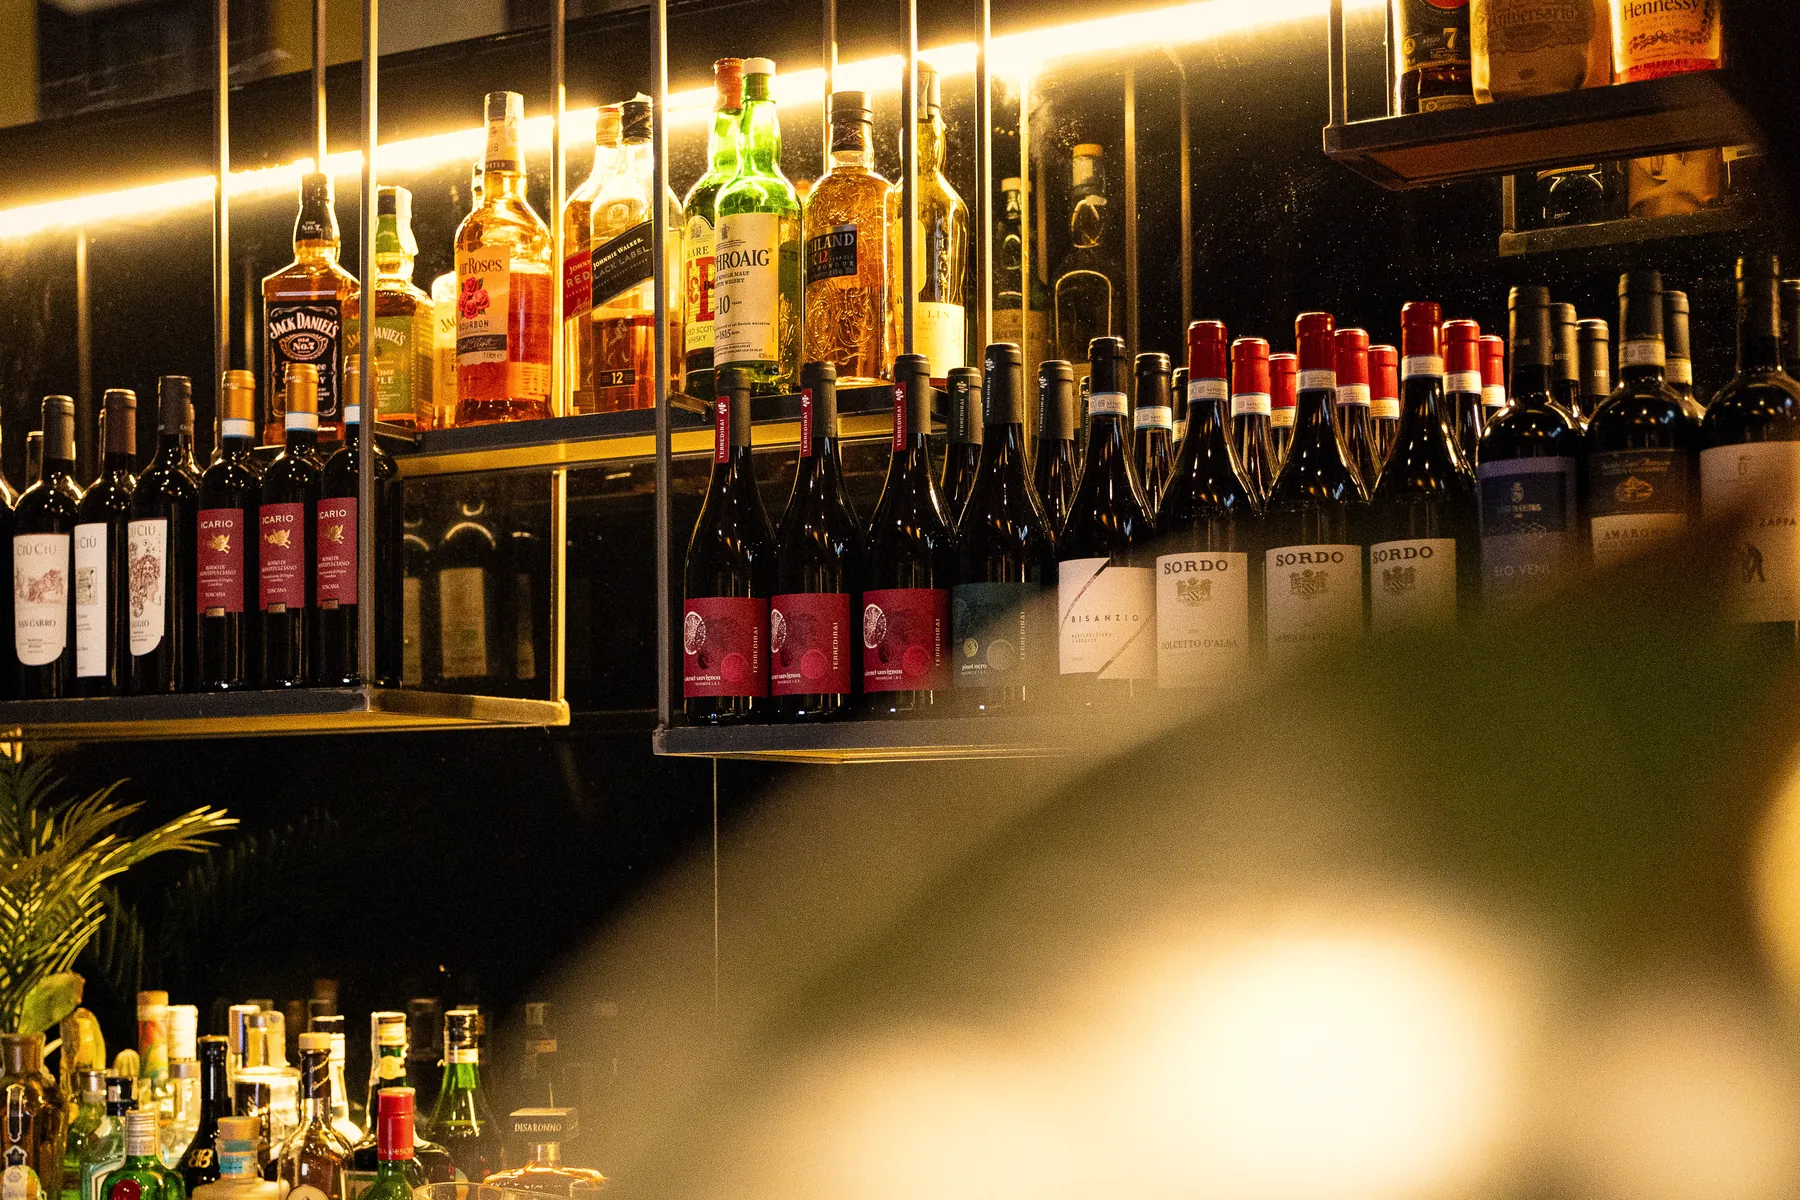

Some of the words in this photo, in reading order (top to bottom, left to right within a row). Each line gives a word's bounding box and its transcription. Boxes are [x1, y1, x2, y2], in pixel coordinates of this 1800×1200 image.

[1624, 0, 1698, 20] Hennessy
[1443, 28, 1458, 49] 7
[811, 233, 854, 253] HLAND
[593, 251, 618, 271] JOHNNIE
[716, 249, 769, 272] HROAIG
[593, 261, 617, 280] LACK
[566, 271, 590, 289] RED
[719, 294, 730, 315] 10
[269, 317, 298, 339] JACK
[296, 312, 340, 340] DANIEL'S
[292, 341, 315, 350] No.7
[611, 372, 624, 385] 12
[201, 520, 234, 528] ICARIO
[262, 514, 294, 524] ICARIO
[1275, 551, 1344, 567] SORDO
[1372, 546, 1434, 564] SORDO
[1164, 560, 1228, 575] SORDO
[1071, 614, 1139, 623] BISANZIO
[514, 1123, 562, 1133] DISARONNO
